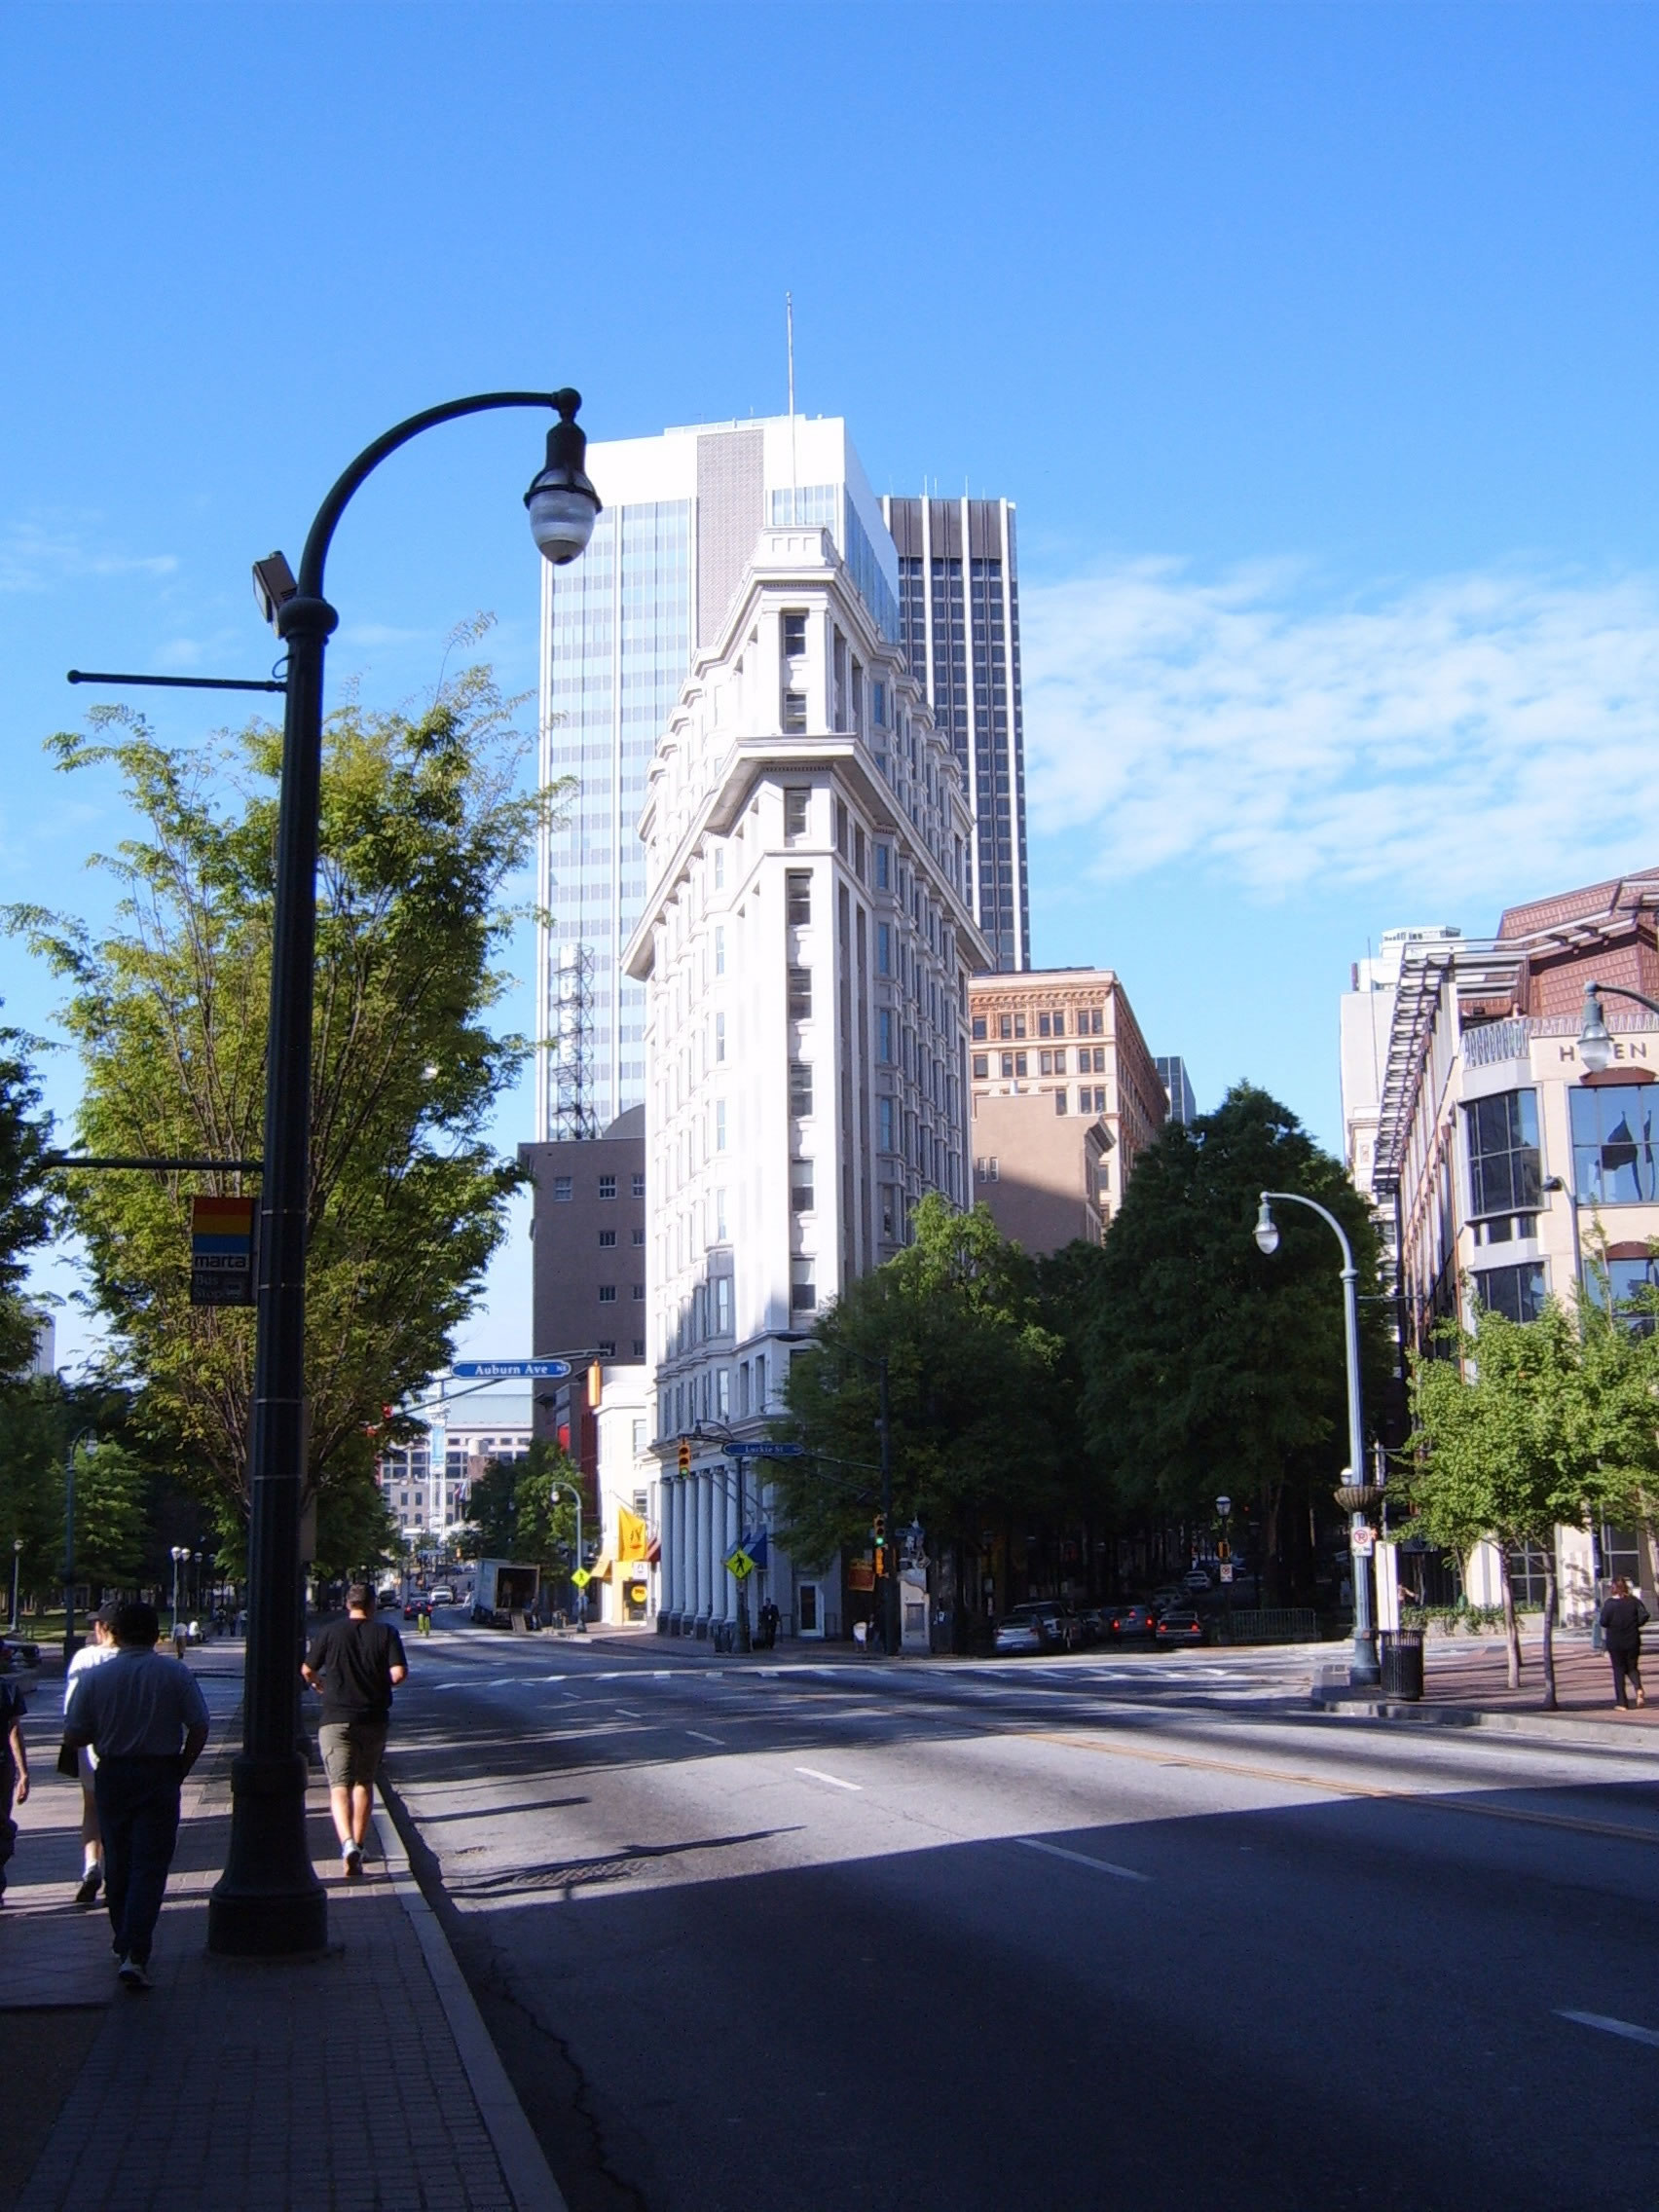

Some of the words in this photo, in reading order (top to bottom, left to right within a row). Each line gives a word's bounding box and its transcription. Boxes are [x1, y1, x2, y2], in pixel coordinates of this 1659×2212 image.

[1559, 1042, 1647, 1062] HEN
[195, 1256, 246, 1268] marta
[474, 1365, 521, 1376] Auburn
[525, 1364, 548, 1375] Ave
[774, 1445, 784, 1454] St
